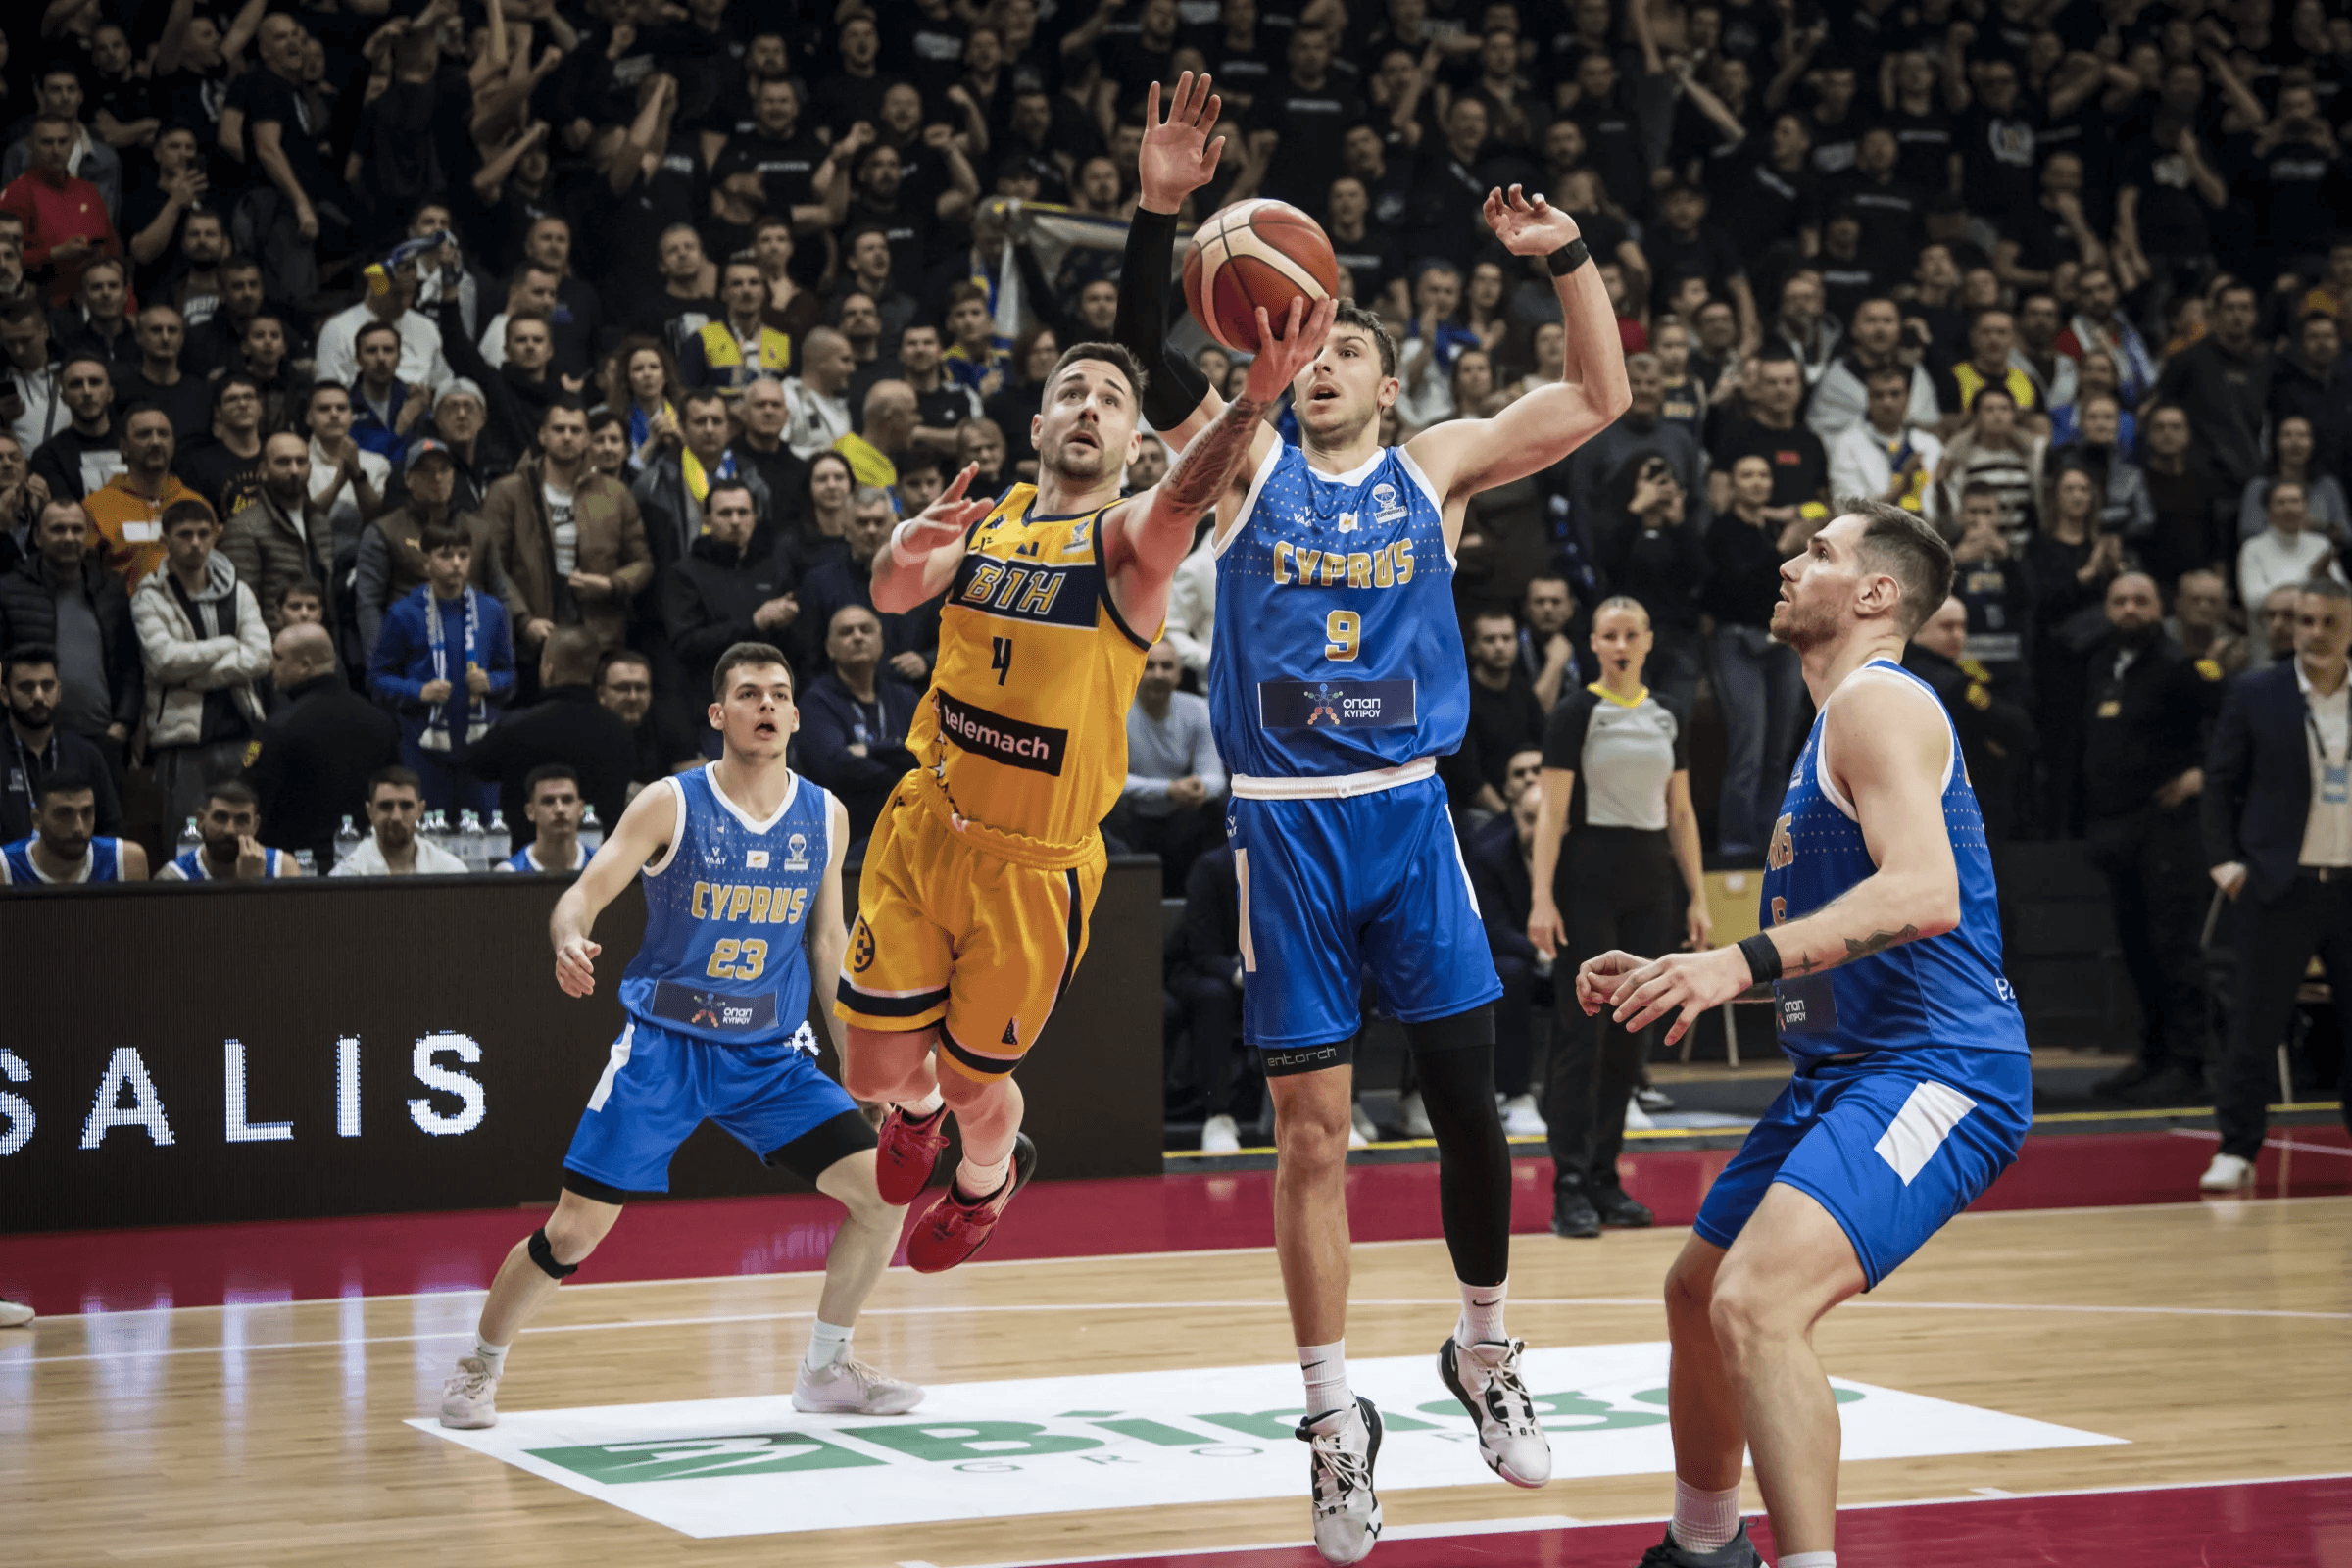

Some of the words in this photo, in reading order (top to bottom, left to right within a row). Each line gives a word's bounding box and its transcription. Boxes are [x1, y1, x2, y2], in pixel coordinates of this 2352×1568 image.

[961, 562, 1067, 615] BIH
[1273, 537, 1415, 589] CYPRUS
[991, 635, 1013, 687] 4
[1325, 610, 1361, 662] 9
[944, 705, 1050, 760] telemach
[691, 880, 808, 924] CYPRUS
[706, 938, 768, 981] 23
[1267, 1046, 1337, 1067] entorch
[833, 1384, 1867, 1462] Bing
[952, 1431, 1477, 1473] GROP
